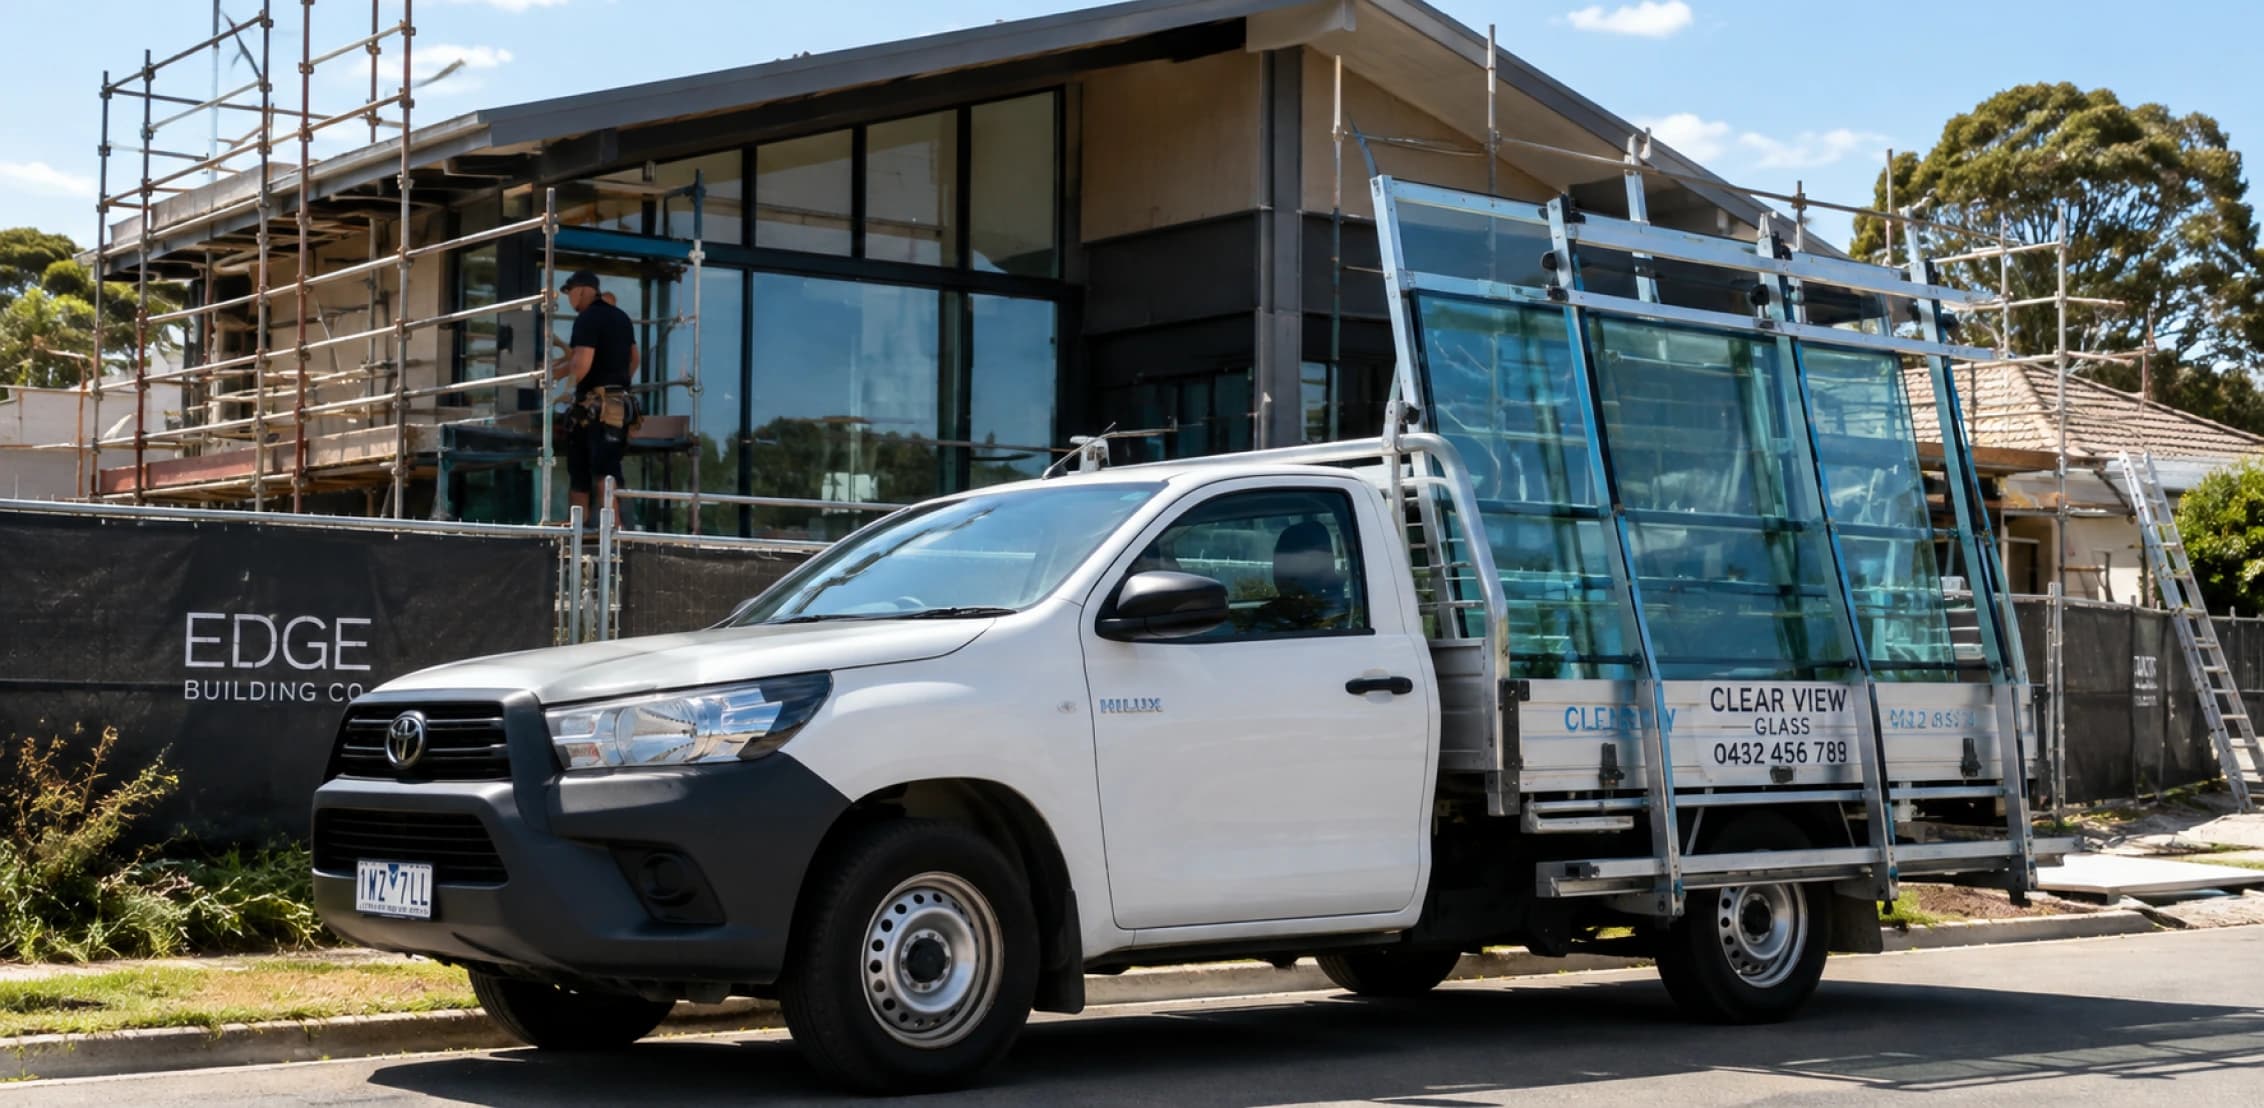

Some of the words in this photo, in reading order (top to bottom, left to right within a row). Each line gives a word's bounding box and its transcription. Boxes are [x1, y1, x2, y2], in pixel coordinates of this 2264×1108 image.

[185, 612, 372, 671] EDGE
[184, 679, 317, 701] BUILDING
[1710, 686, 1785, 713] CLEAR
[1792, 687, 1847, 713] VIEW
[1099, 697, 1163, 714] HILUX
[1754, 716, 1811, 736] GLASS
[1713, 741, 1765, 765] 0432
[1770, 741, 1808, 764] 456
[1813, 740, 1847, 763] 789
[399, 870, 429, 906] 7LL
